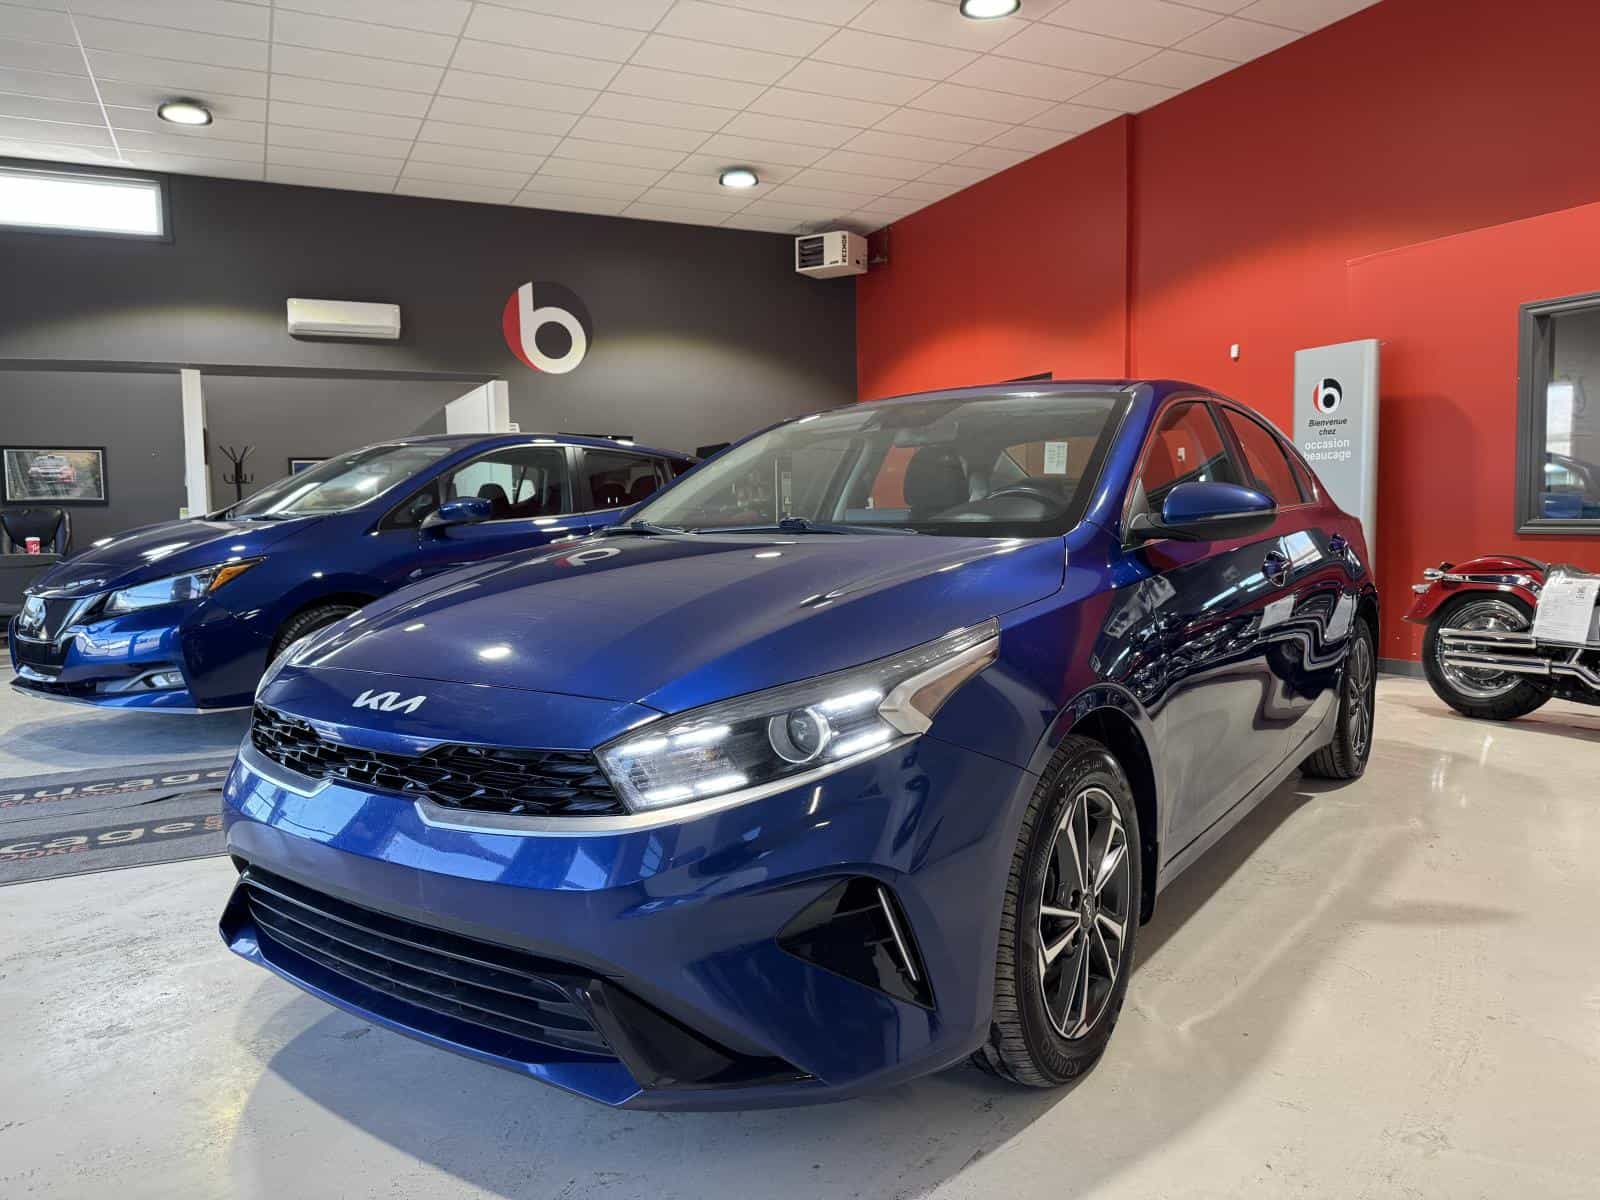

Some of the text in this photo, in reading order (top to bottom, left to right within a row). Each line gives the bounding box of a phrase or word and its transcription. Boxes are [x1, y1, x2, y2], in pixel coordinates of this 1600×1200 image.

[518, 281, 587, 374] b
[1308, 418, 1348, 428] Bienvenue
[1318, 427, 1337, 436] chez
[1304, 438, 1350, 450] occasion
[1304, 449, 1352, 462] beaucage
[352, 689, 427, 714] KIA
